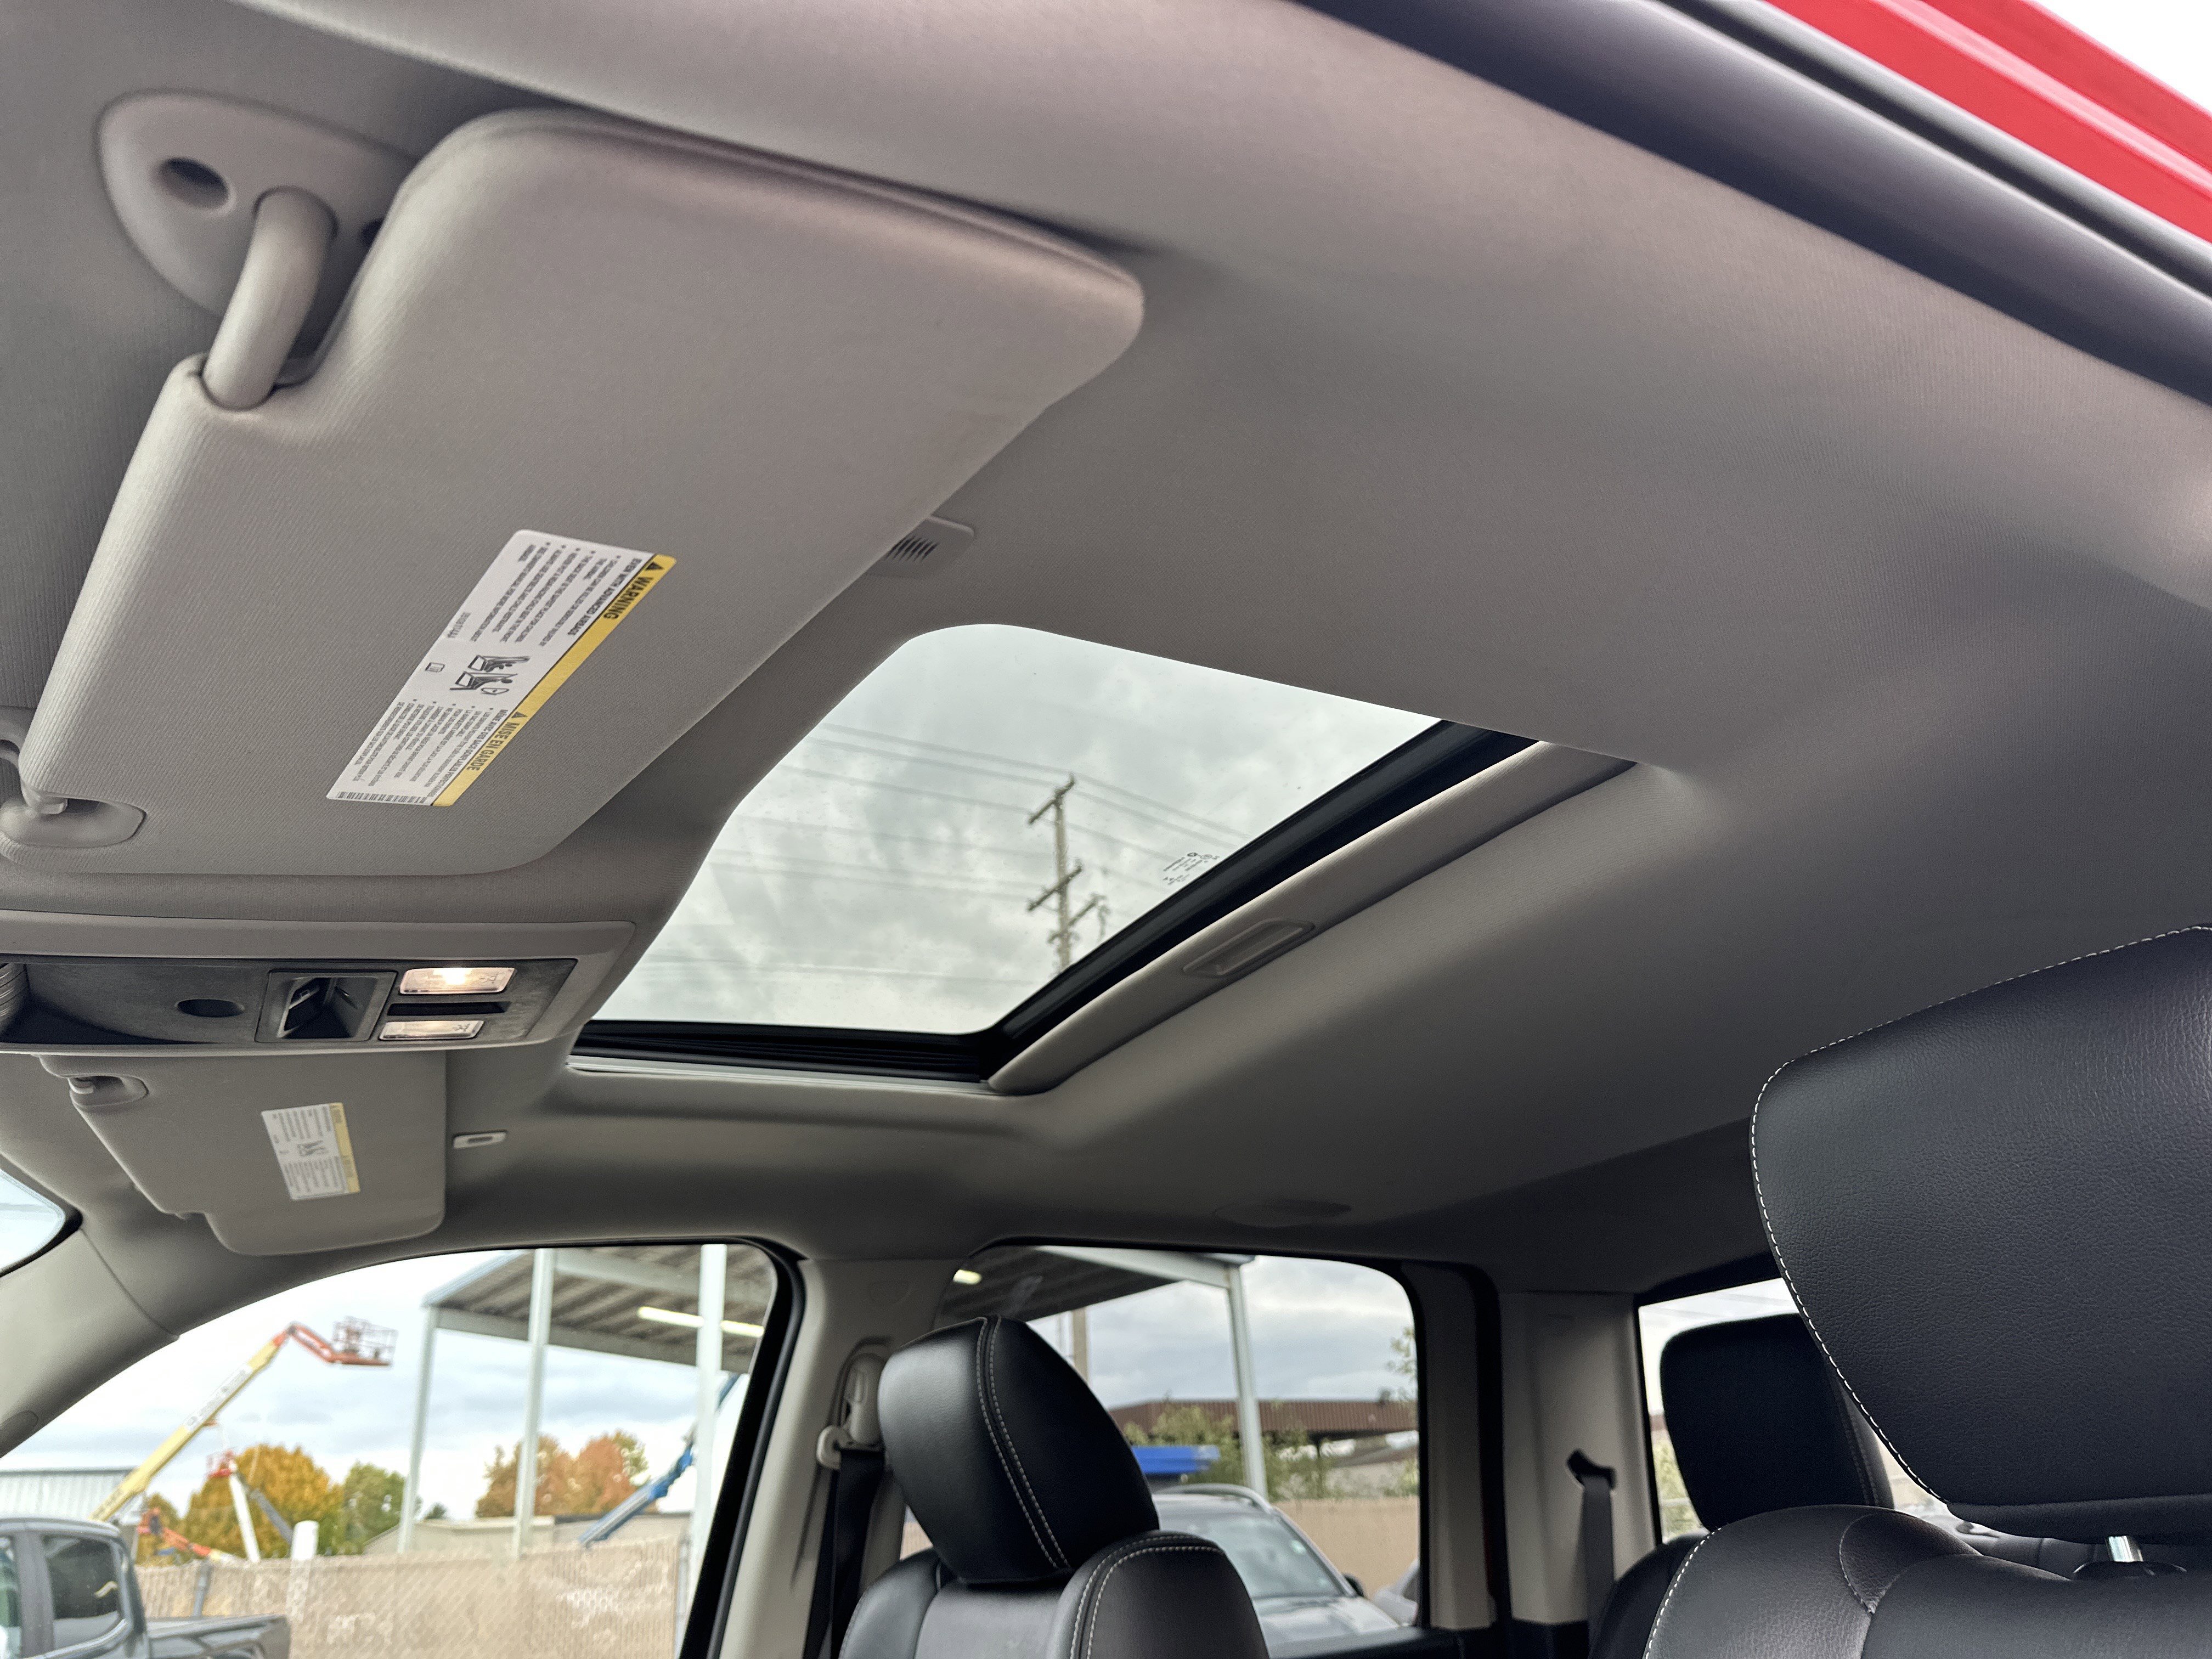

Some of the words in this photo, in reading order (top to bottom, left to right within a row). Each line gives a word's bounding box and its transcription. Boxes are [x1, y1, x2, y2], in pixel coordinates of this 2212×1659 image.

[603, 577, 654, 619] WARNING
[495, 722, 520, 739] MISE
[486, 740, 503, 749] EN
[466, 750, 494, 771] GARDE
